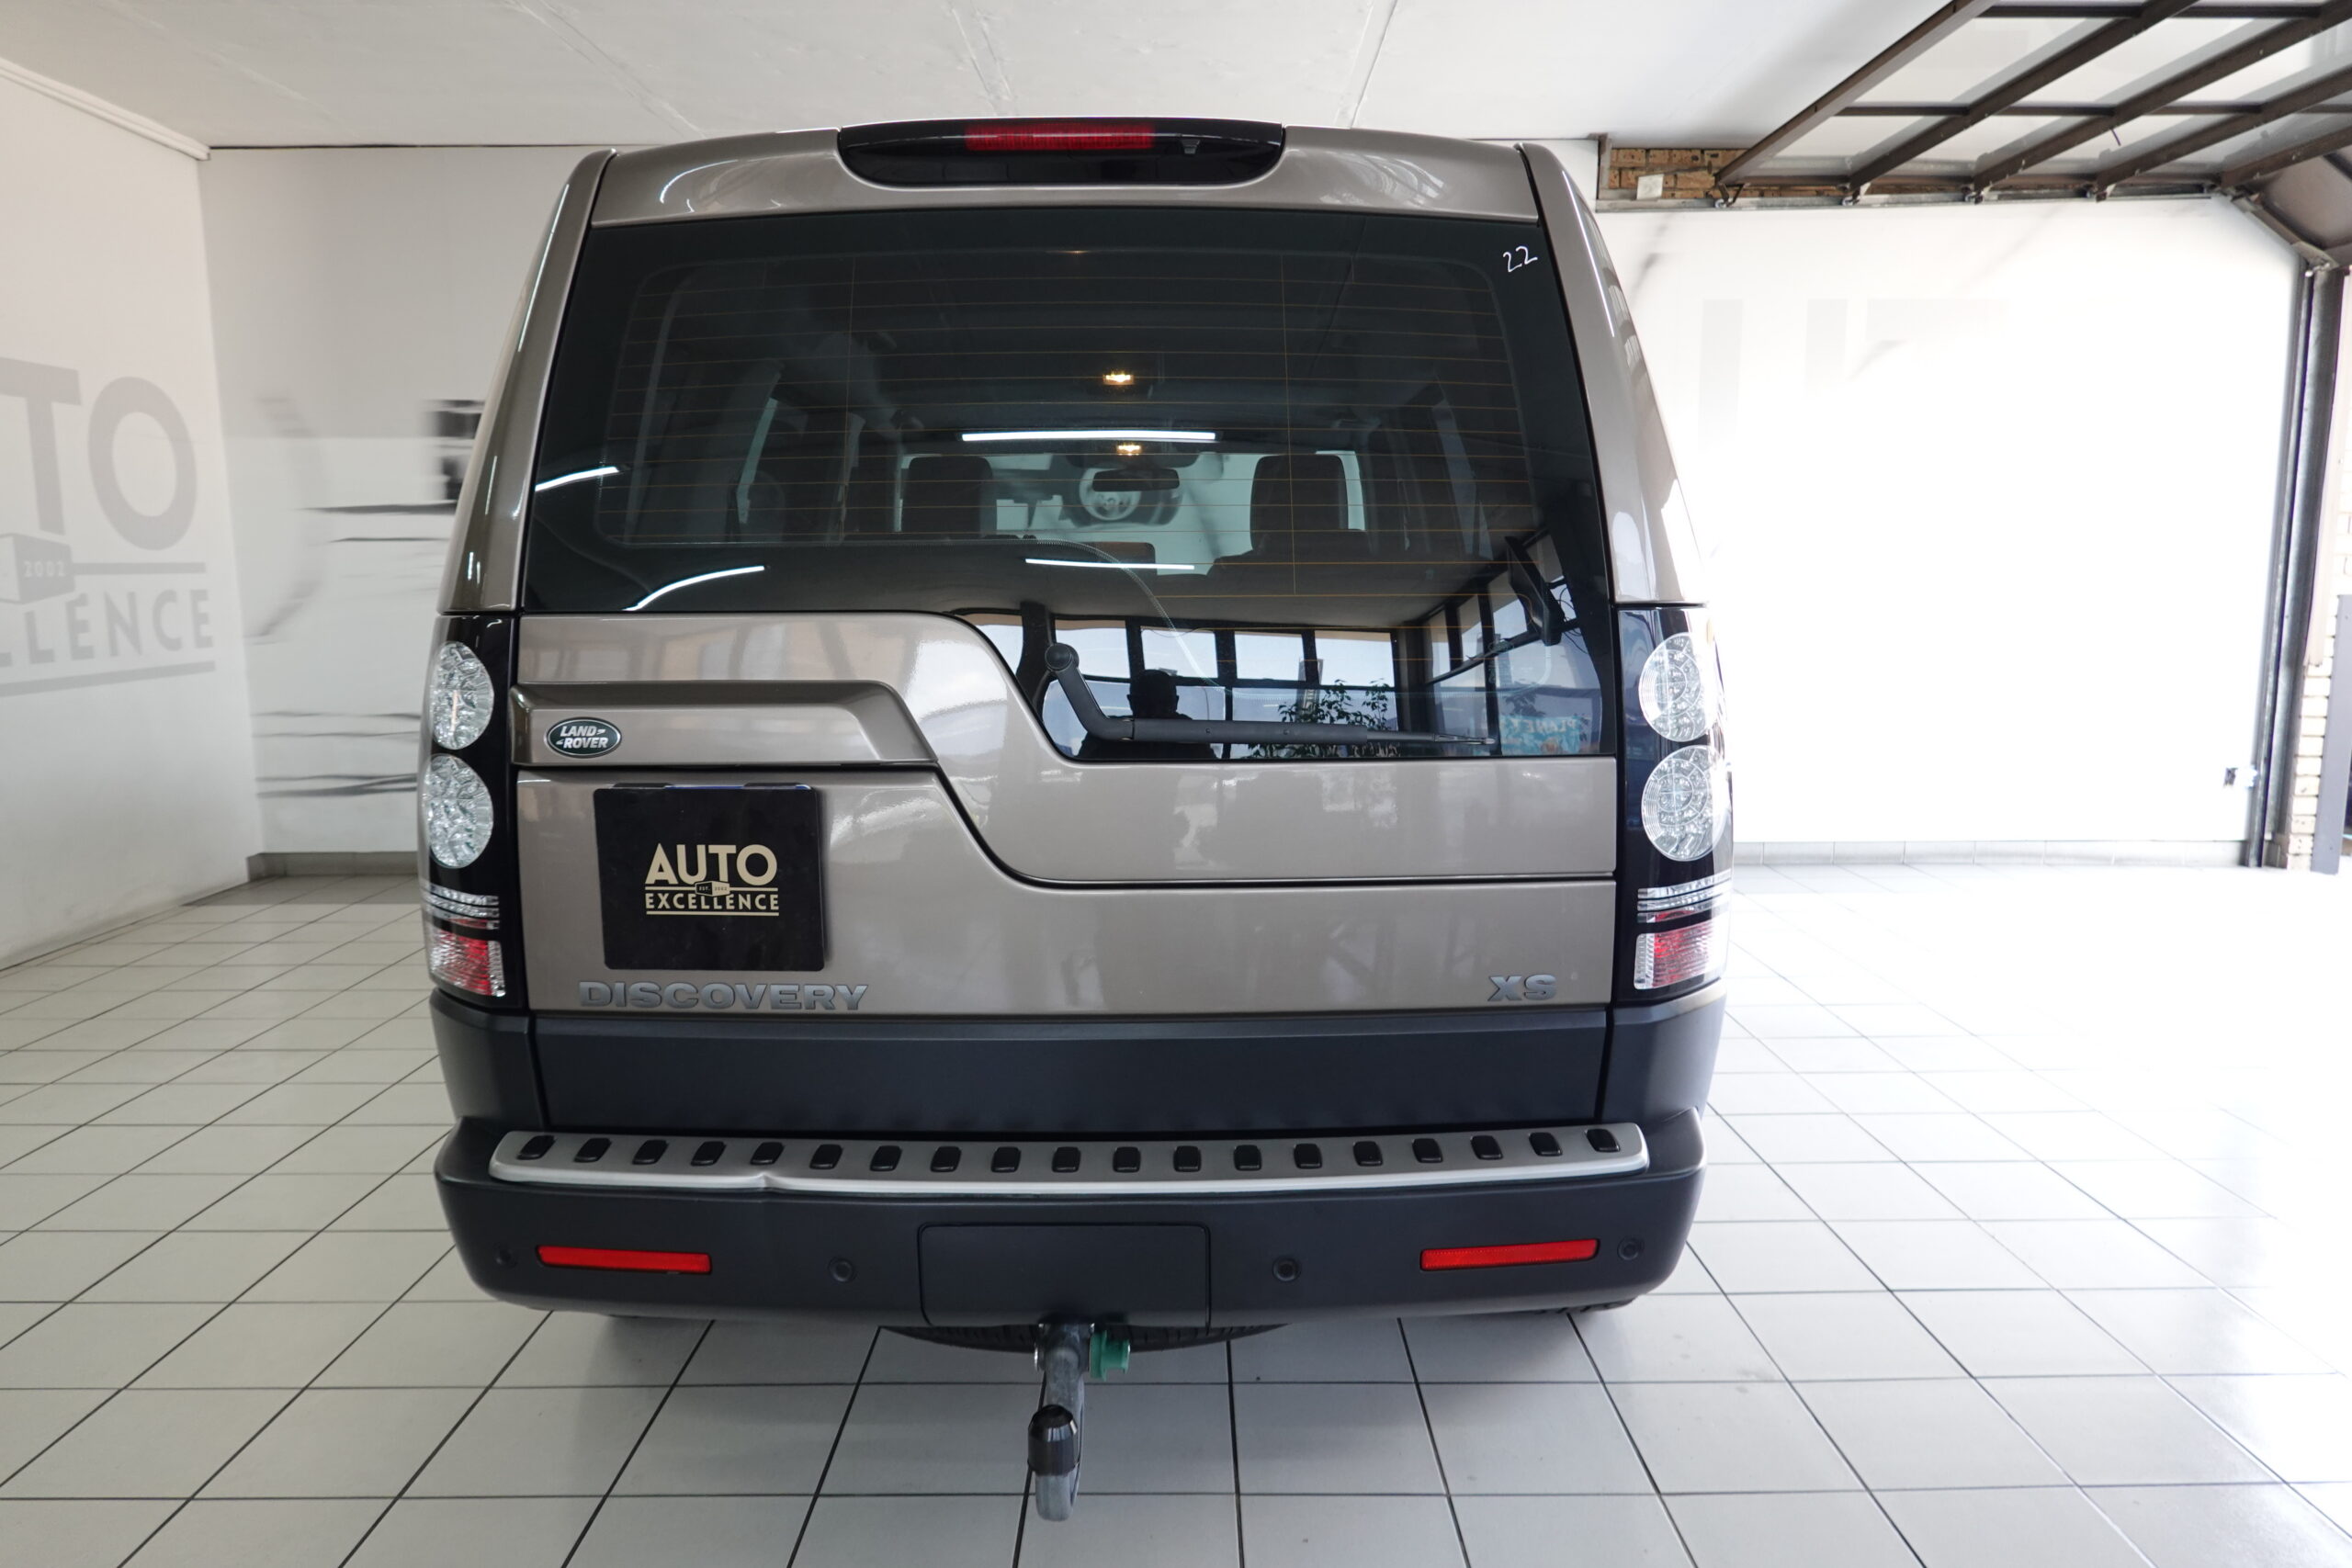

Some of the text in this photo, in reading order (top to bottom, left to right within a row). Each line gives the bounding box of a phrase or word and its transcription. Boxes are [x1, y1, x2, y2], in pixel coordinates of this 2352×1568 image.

[1503, 245, 1538, 272] 22
[24, 560, 66, 578] 2002
[0, 588, 214, 668] LENCE
[560, 725, 597, 737] LAND
[563, 737, 608, 749] ROVER
[645, 843, 777, 886] AUTO
[645, 893, 779, 910] EXCELLENCE
[579, 981, 868, 1010] DISCOVERY
[1487, 974, 1556, 1001] XS
